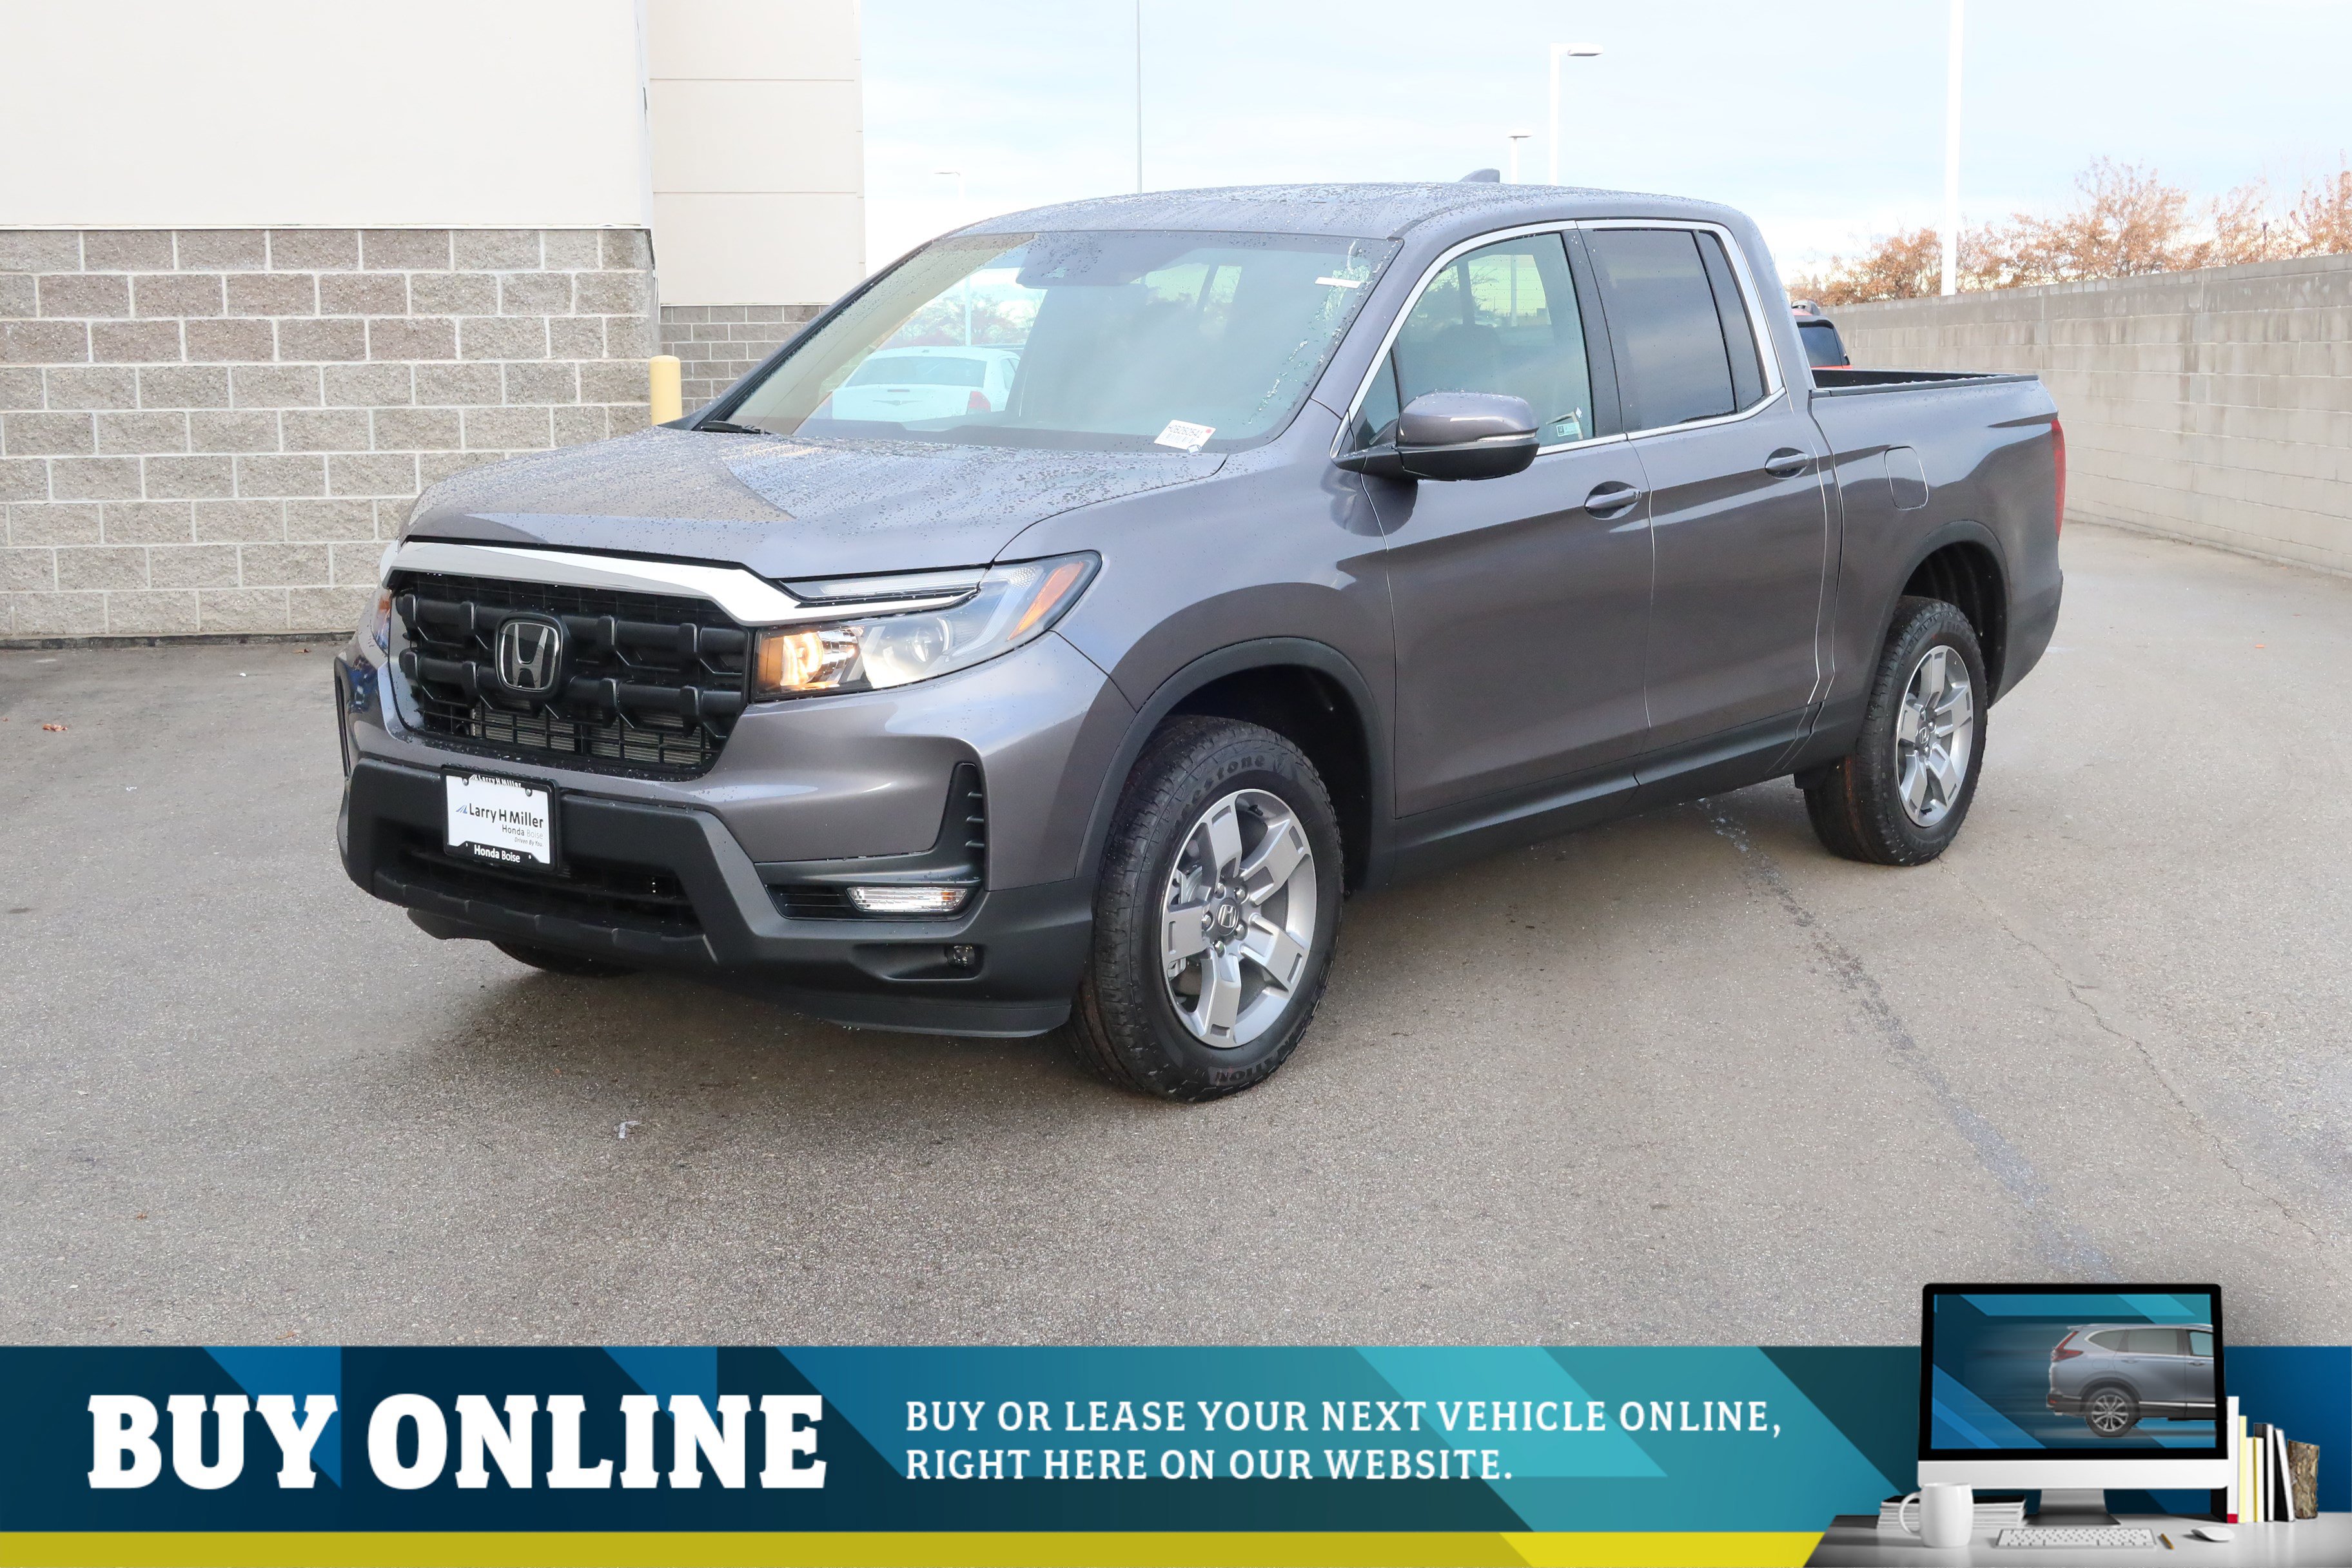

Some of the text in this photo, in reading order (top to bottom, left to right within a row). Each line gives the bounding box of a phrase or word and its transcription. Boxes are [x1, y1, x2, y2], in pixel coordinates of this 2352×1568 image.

[478, 774, 495, 785] Larry
[502, 779, 522, 788] Miller
[469, 803, 544, 828] Larry H Miller
[502, 824, 544, 839] Honda Boise
[474, 845, 520, 863] Honda Boise
